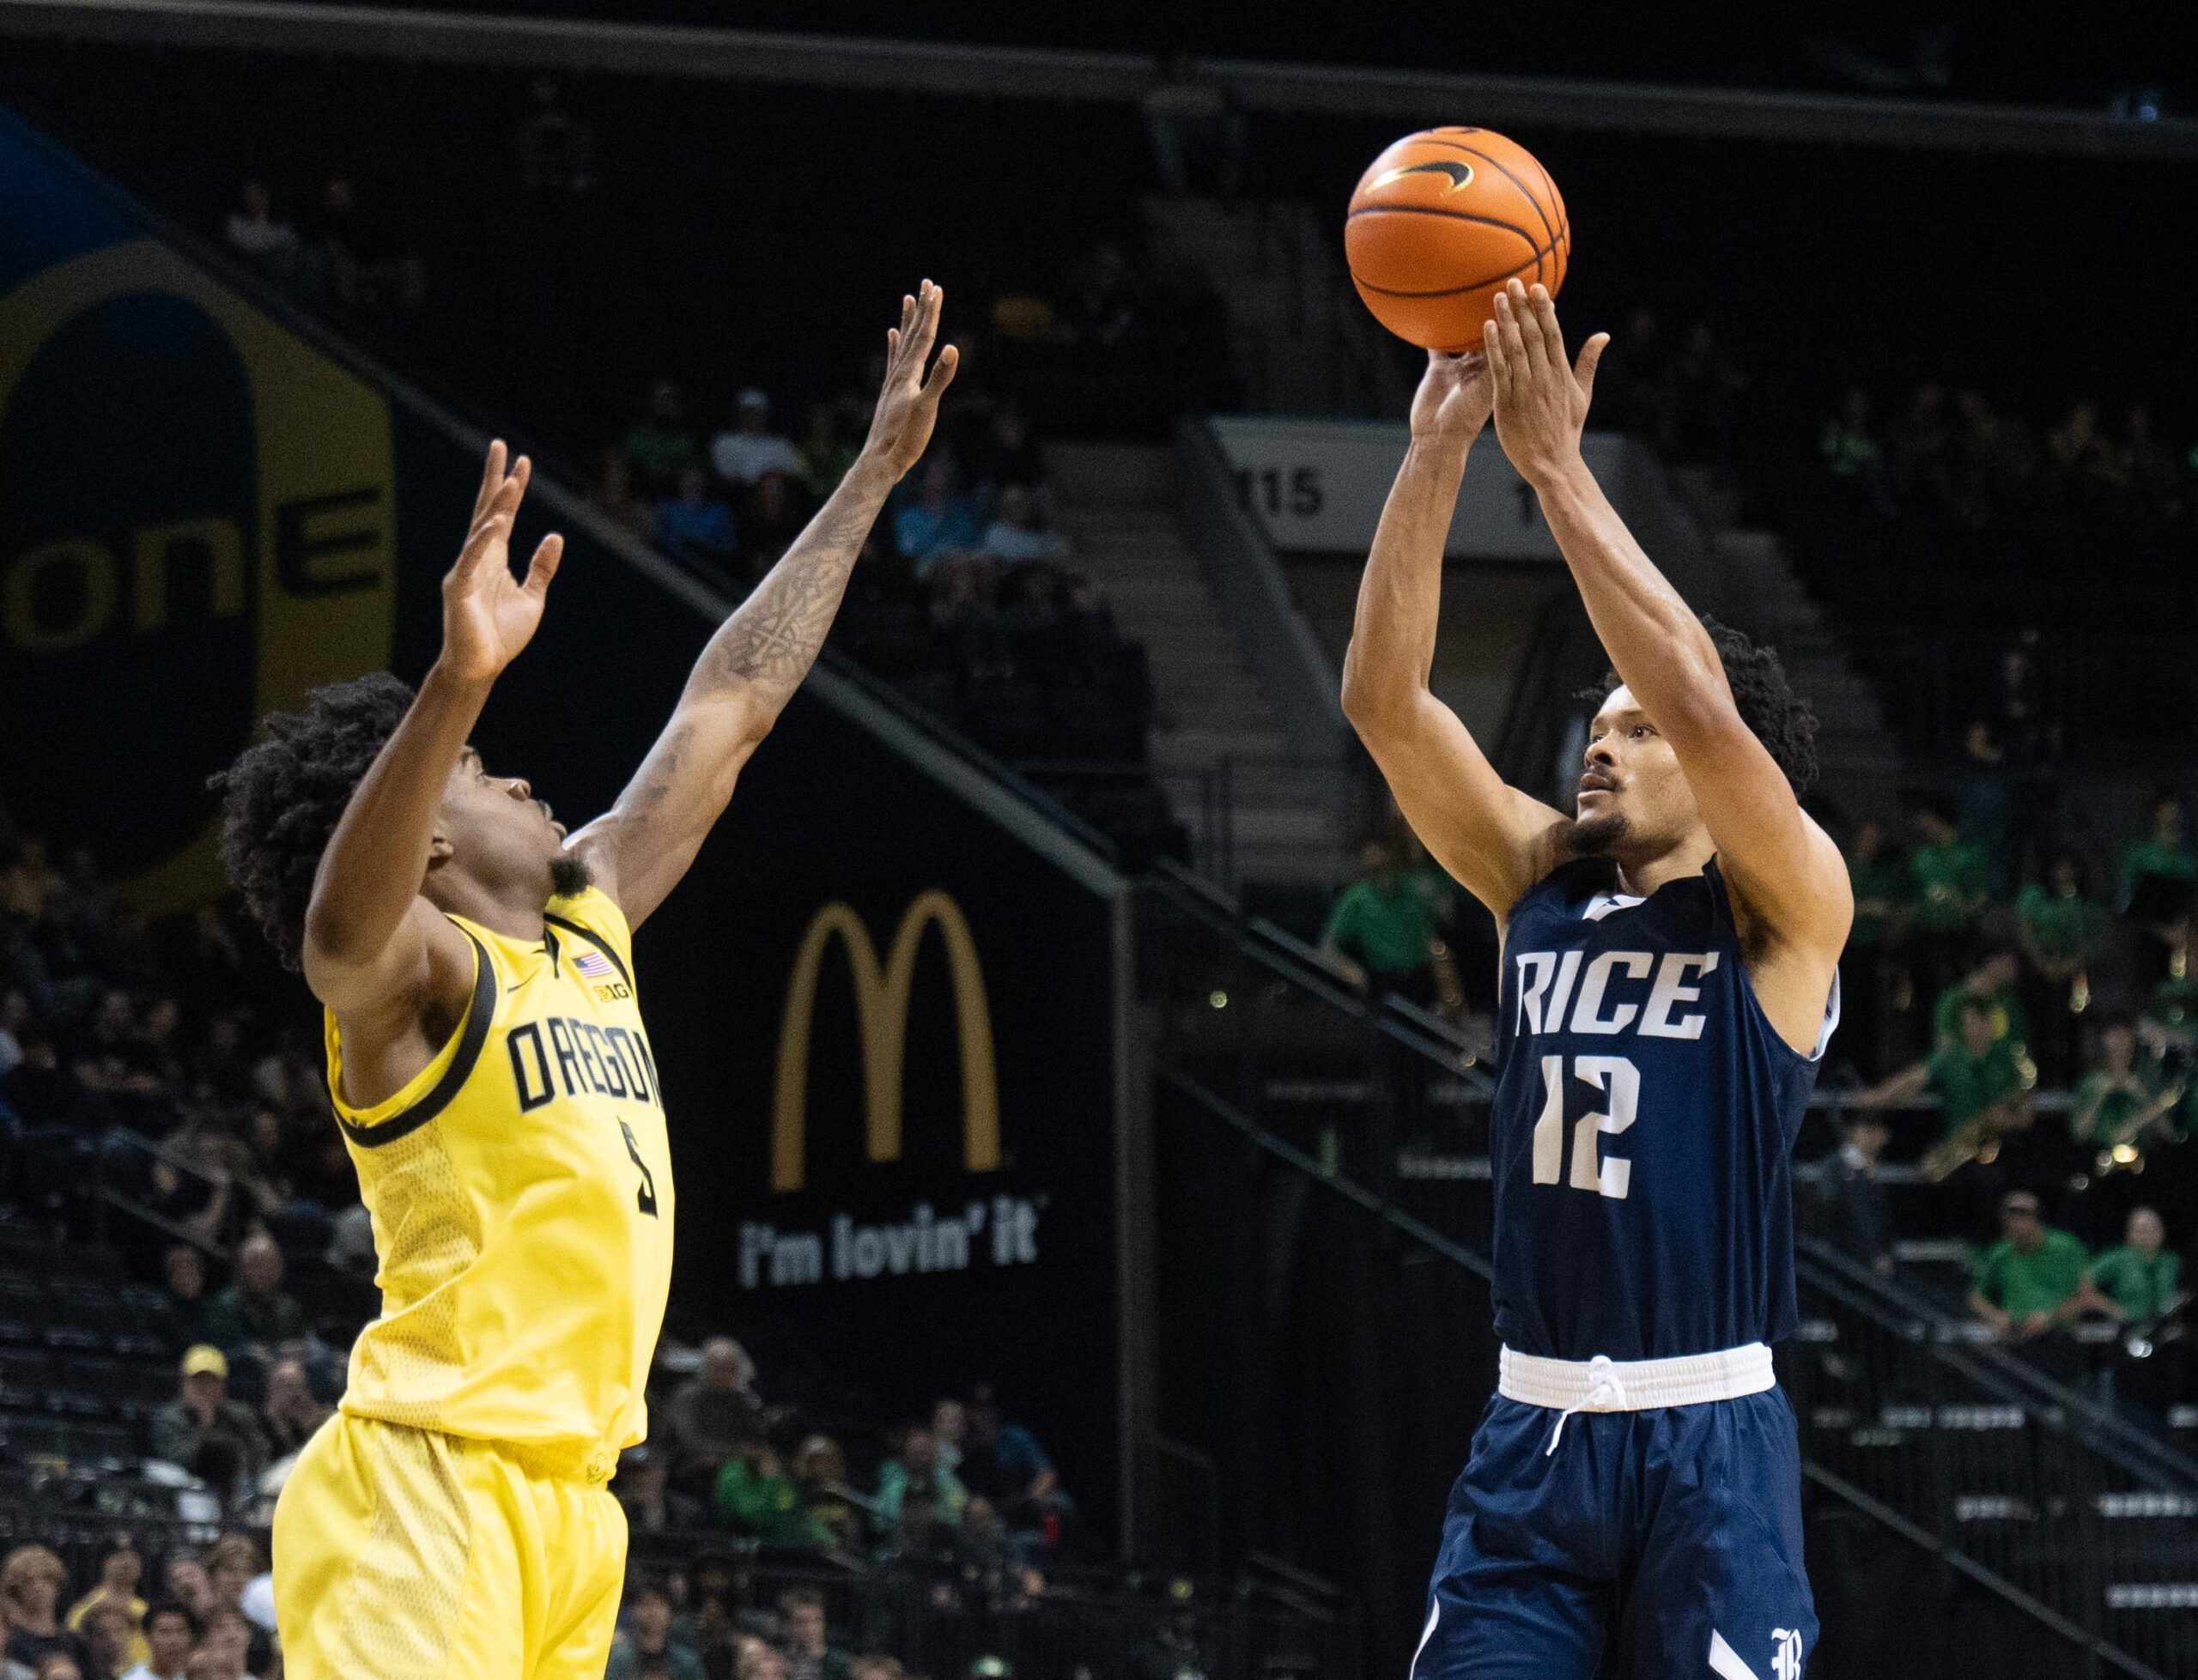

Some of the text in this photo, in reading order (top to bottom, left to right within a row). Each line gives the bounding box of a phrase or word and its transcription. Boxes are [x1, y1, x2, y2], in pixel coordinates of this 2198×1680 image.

[1515, 950, 1720, 1040] RICE
[505, 1016, 664, 1113] OREGON
[617, 1115, 659, 1220] 5
[1533, 1055, 1641, 1199] 12
[831, 1202, 987, 1280] lovin'
[990, 1193, 1038, 1267] it
